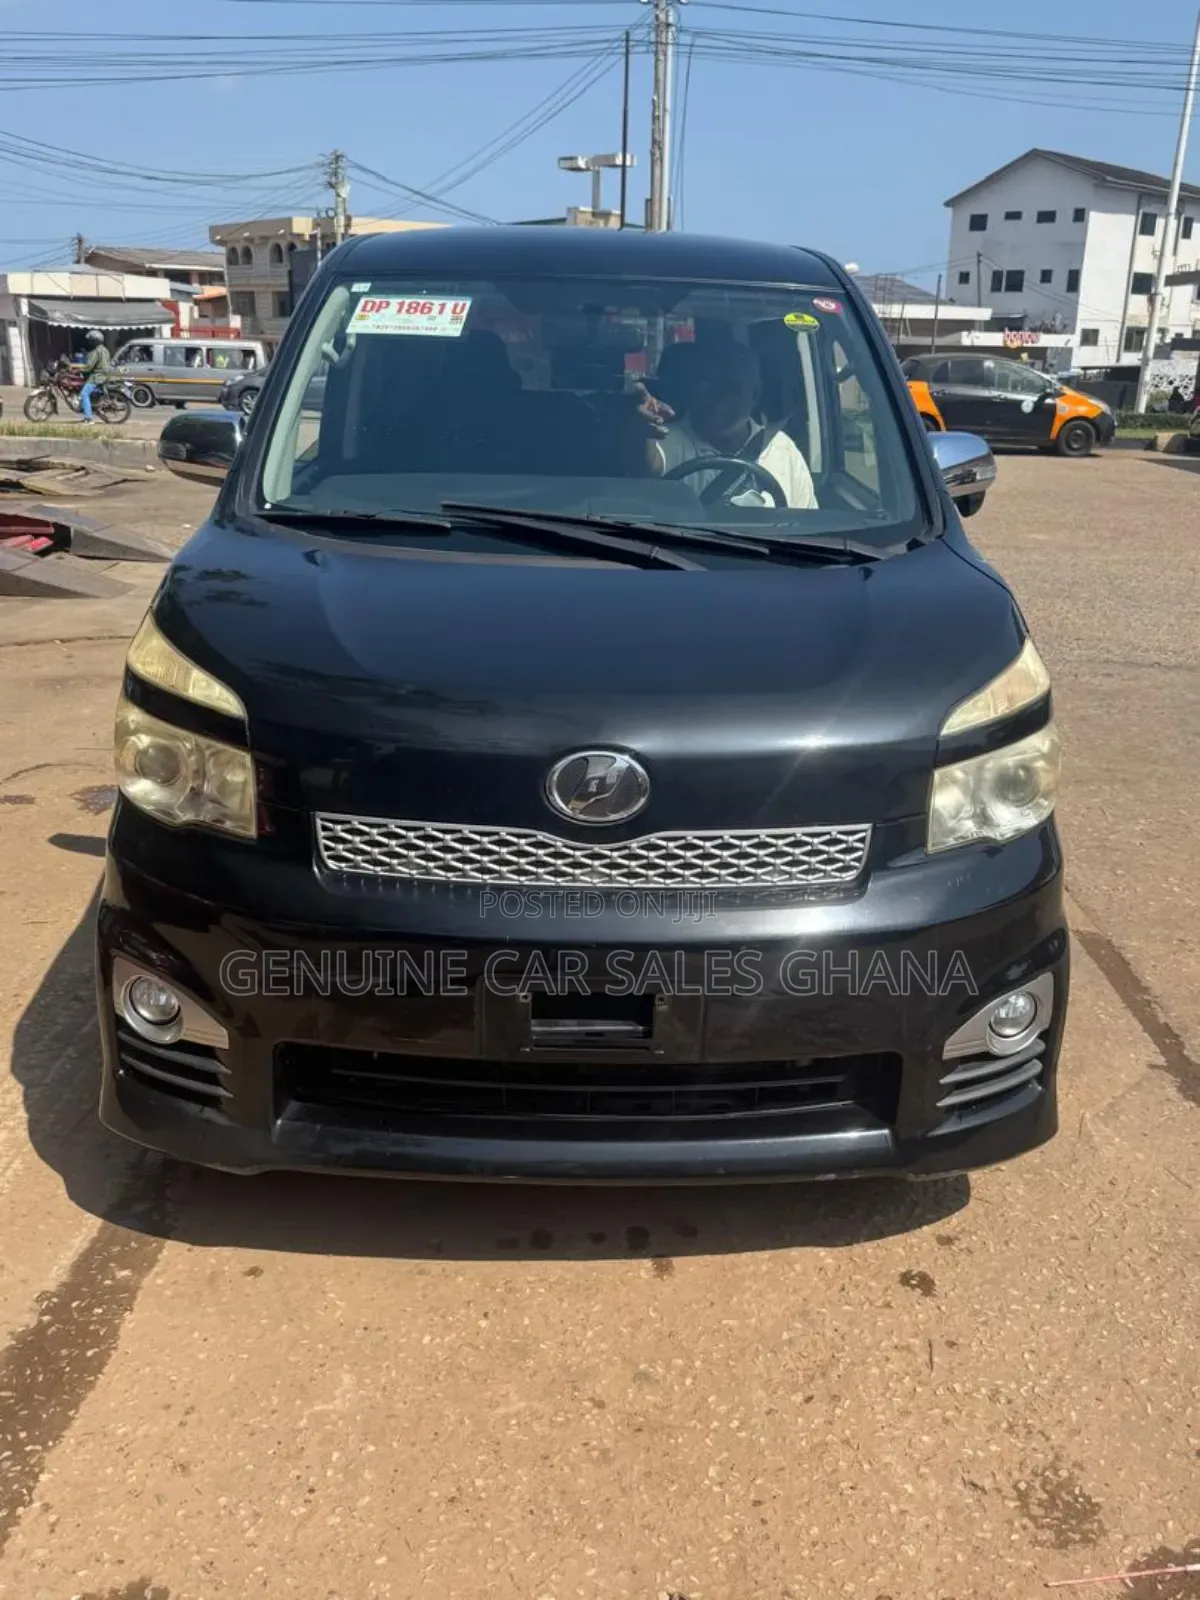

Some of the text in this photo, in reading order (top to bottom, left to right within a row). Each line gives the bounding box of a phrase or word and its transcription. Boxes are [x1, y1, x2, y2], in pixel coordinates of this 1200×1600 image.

[361, 300, 466, 315] DP 1861 U
